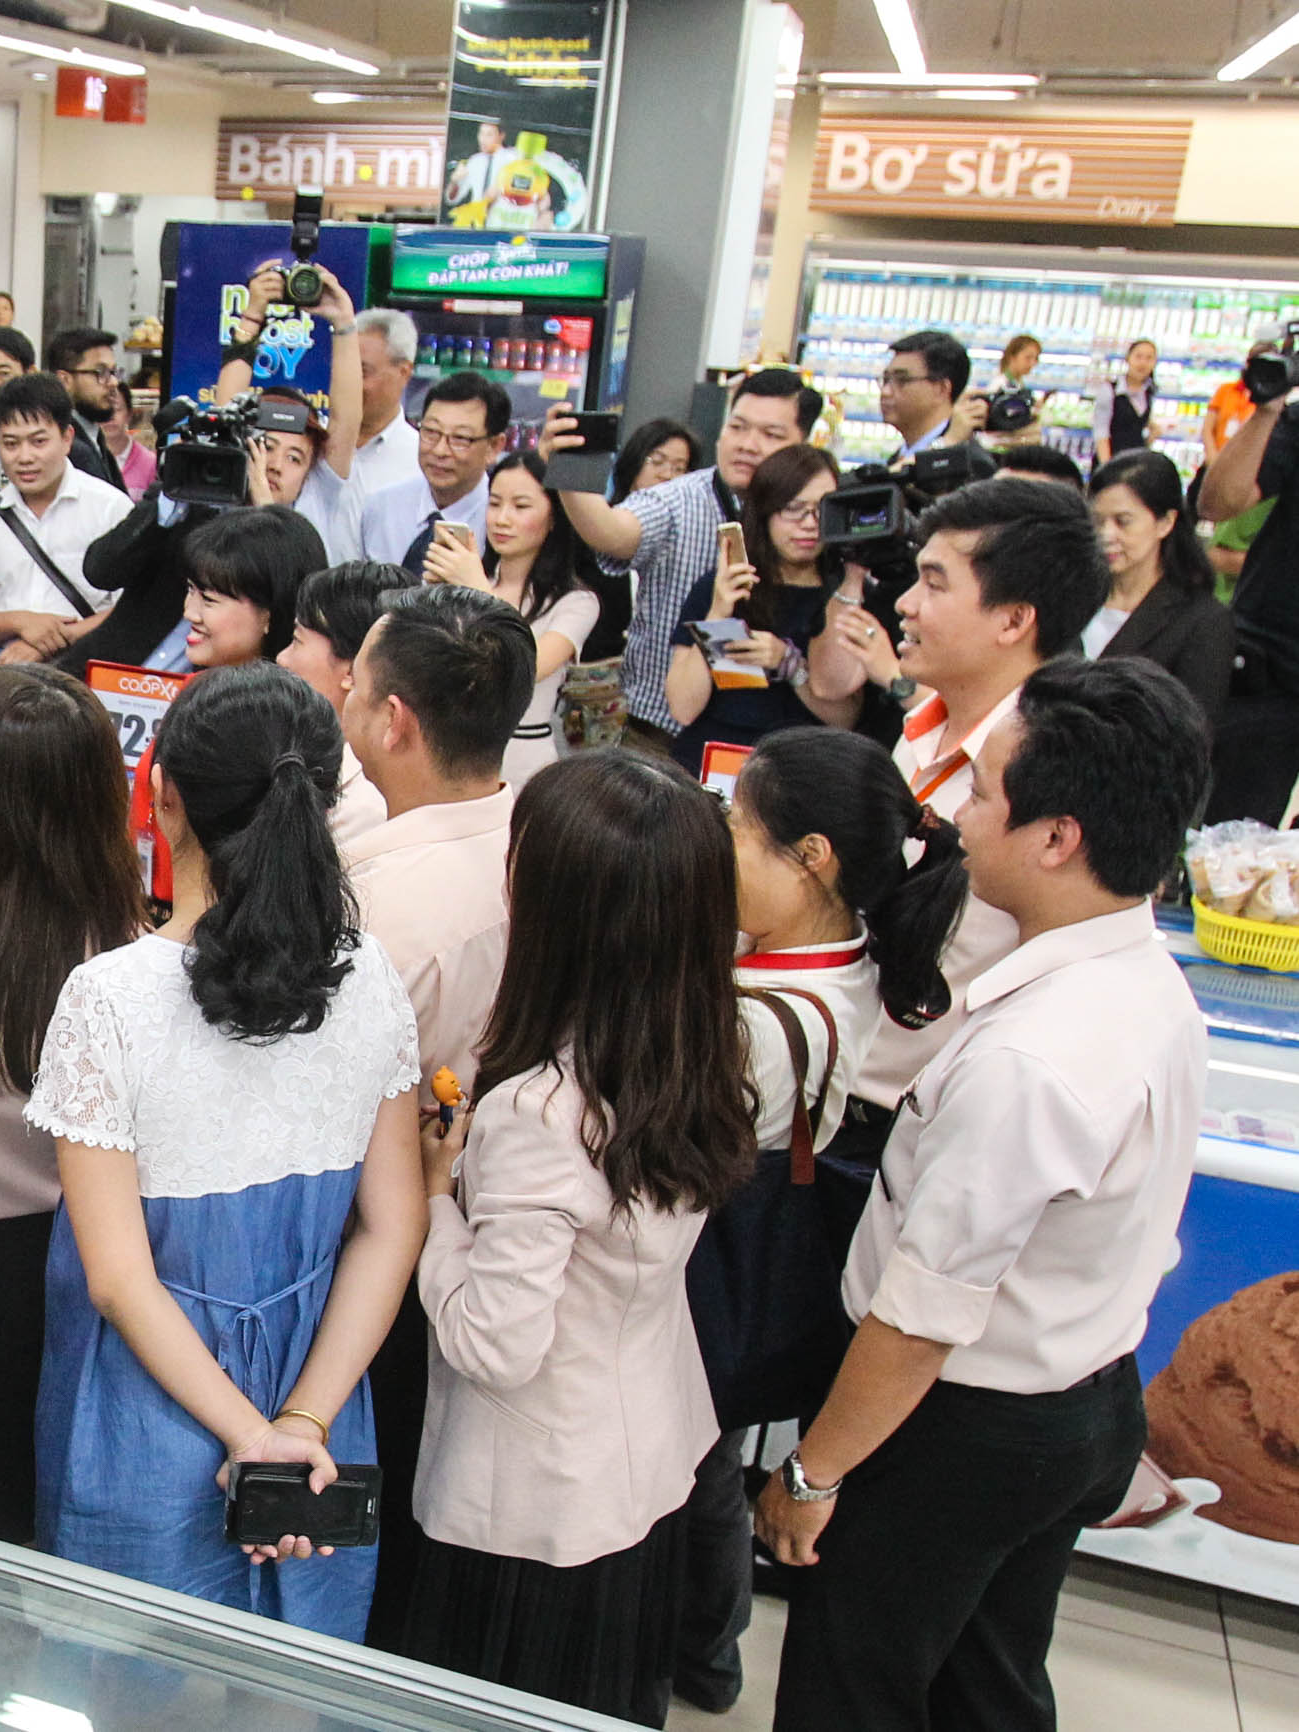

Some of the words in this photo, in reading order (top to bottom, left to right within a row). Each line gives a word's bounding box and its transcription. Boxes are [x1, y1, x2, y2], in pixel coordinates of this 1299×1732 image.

[229, 132, 356, 187] Bánh
[825, 132, 929, 196] Bơ
[942, 134, 1074, 201] sữa
